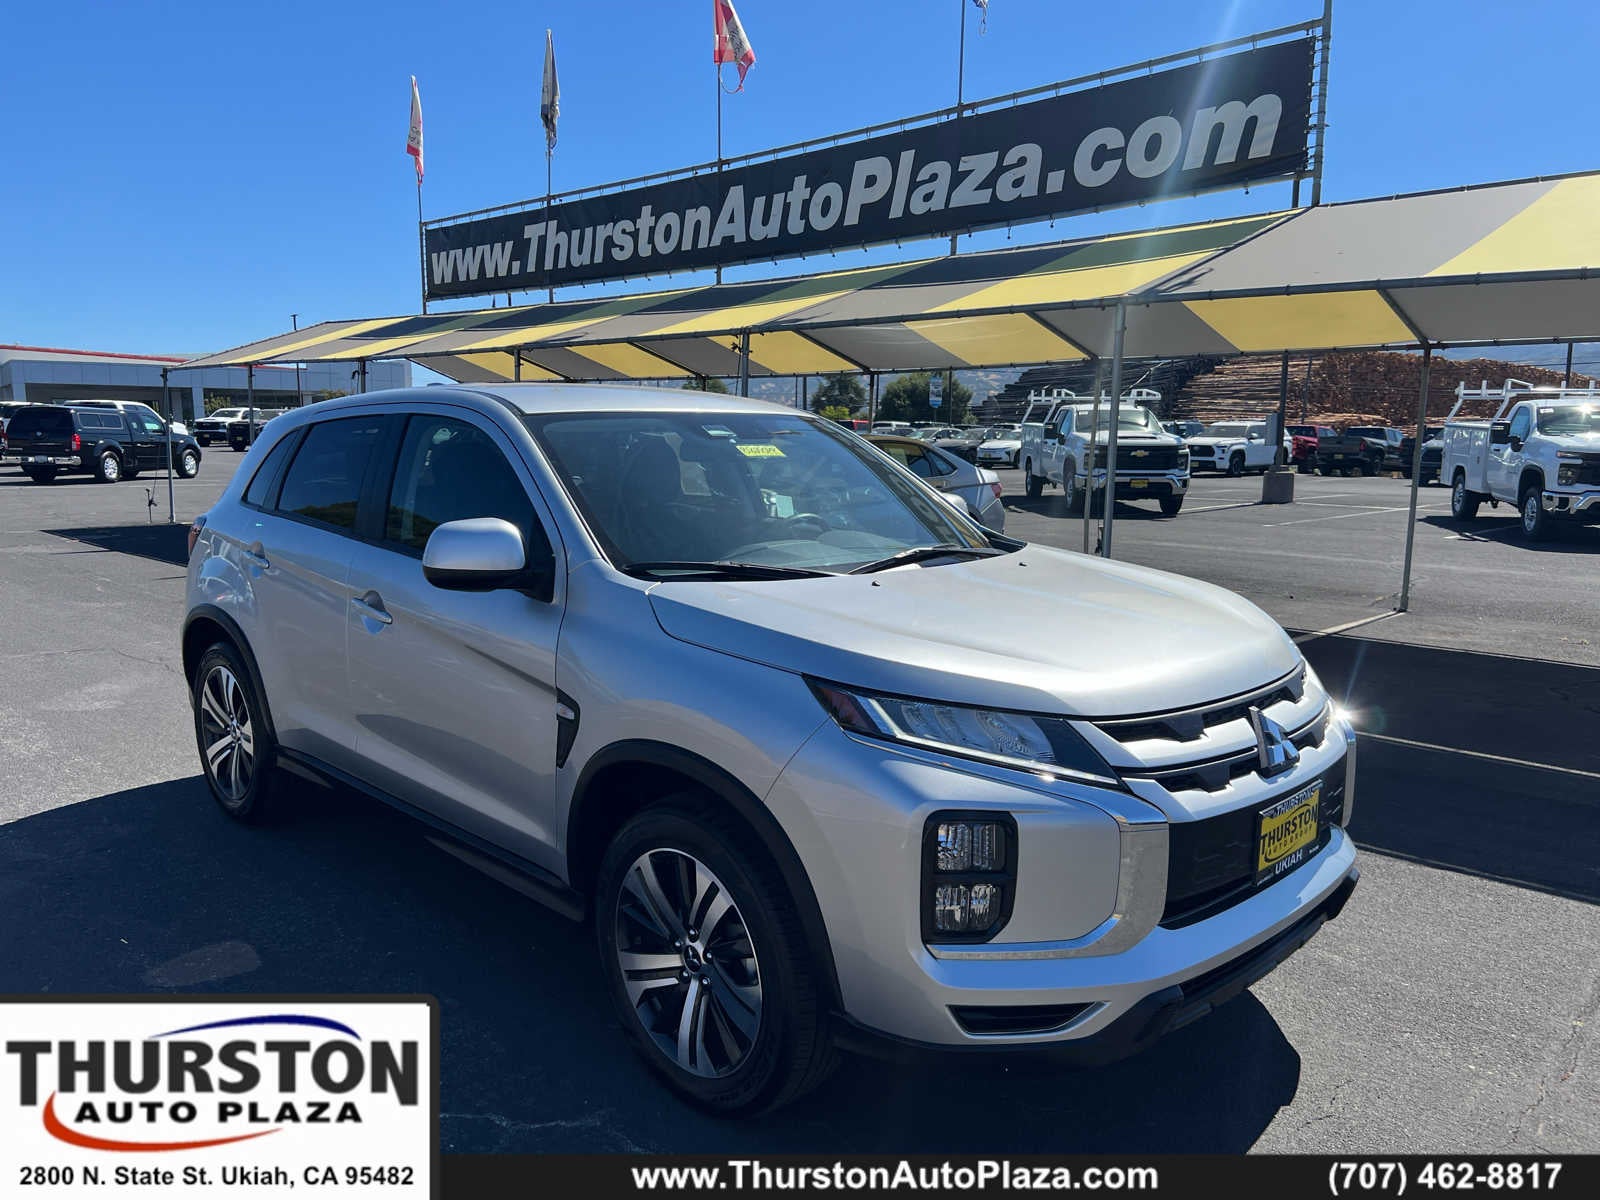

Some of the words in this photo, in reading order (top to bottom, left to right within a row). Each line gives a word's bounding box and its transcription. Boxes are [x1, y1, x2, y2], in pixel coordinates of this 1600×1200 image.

[431, 93, 1283, 285] www.ThurstonAutoPlaza.com
[1260, 803, 1319, 856] THURSTON
[1268, 839, 1288, 857] AUTO
[1275, 848, 1303, 875] UKIAH
